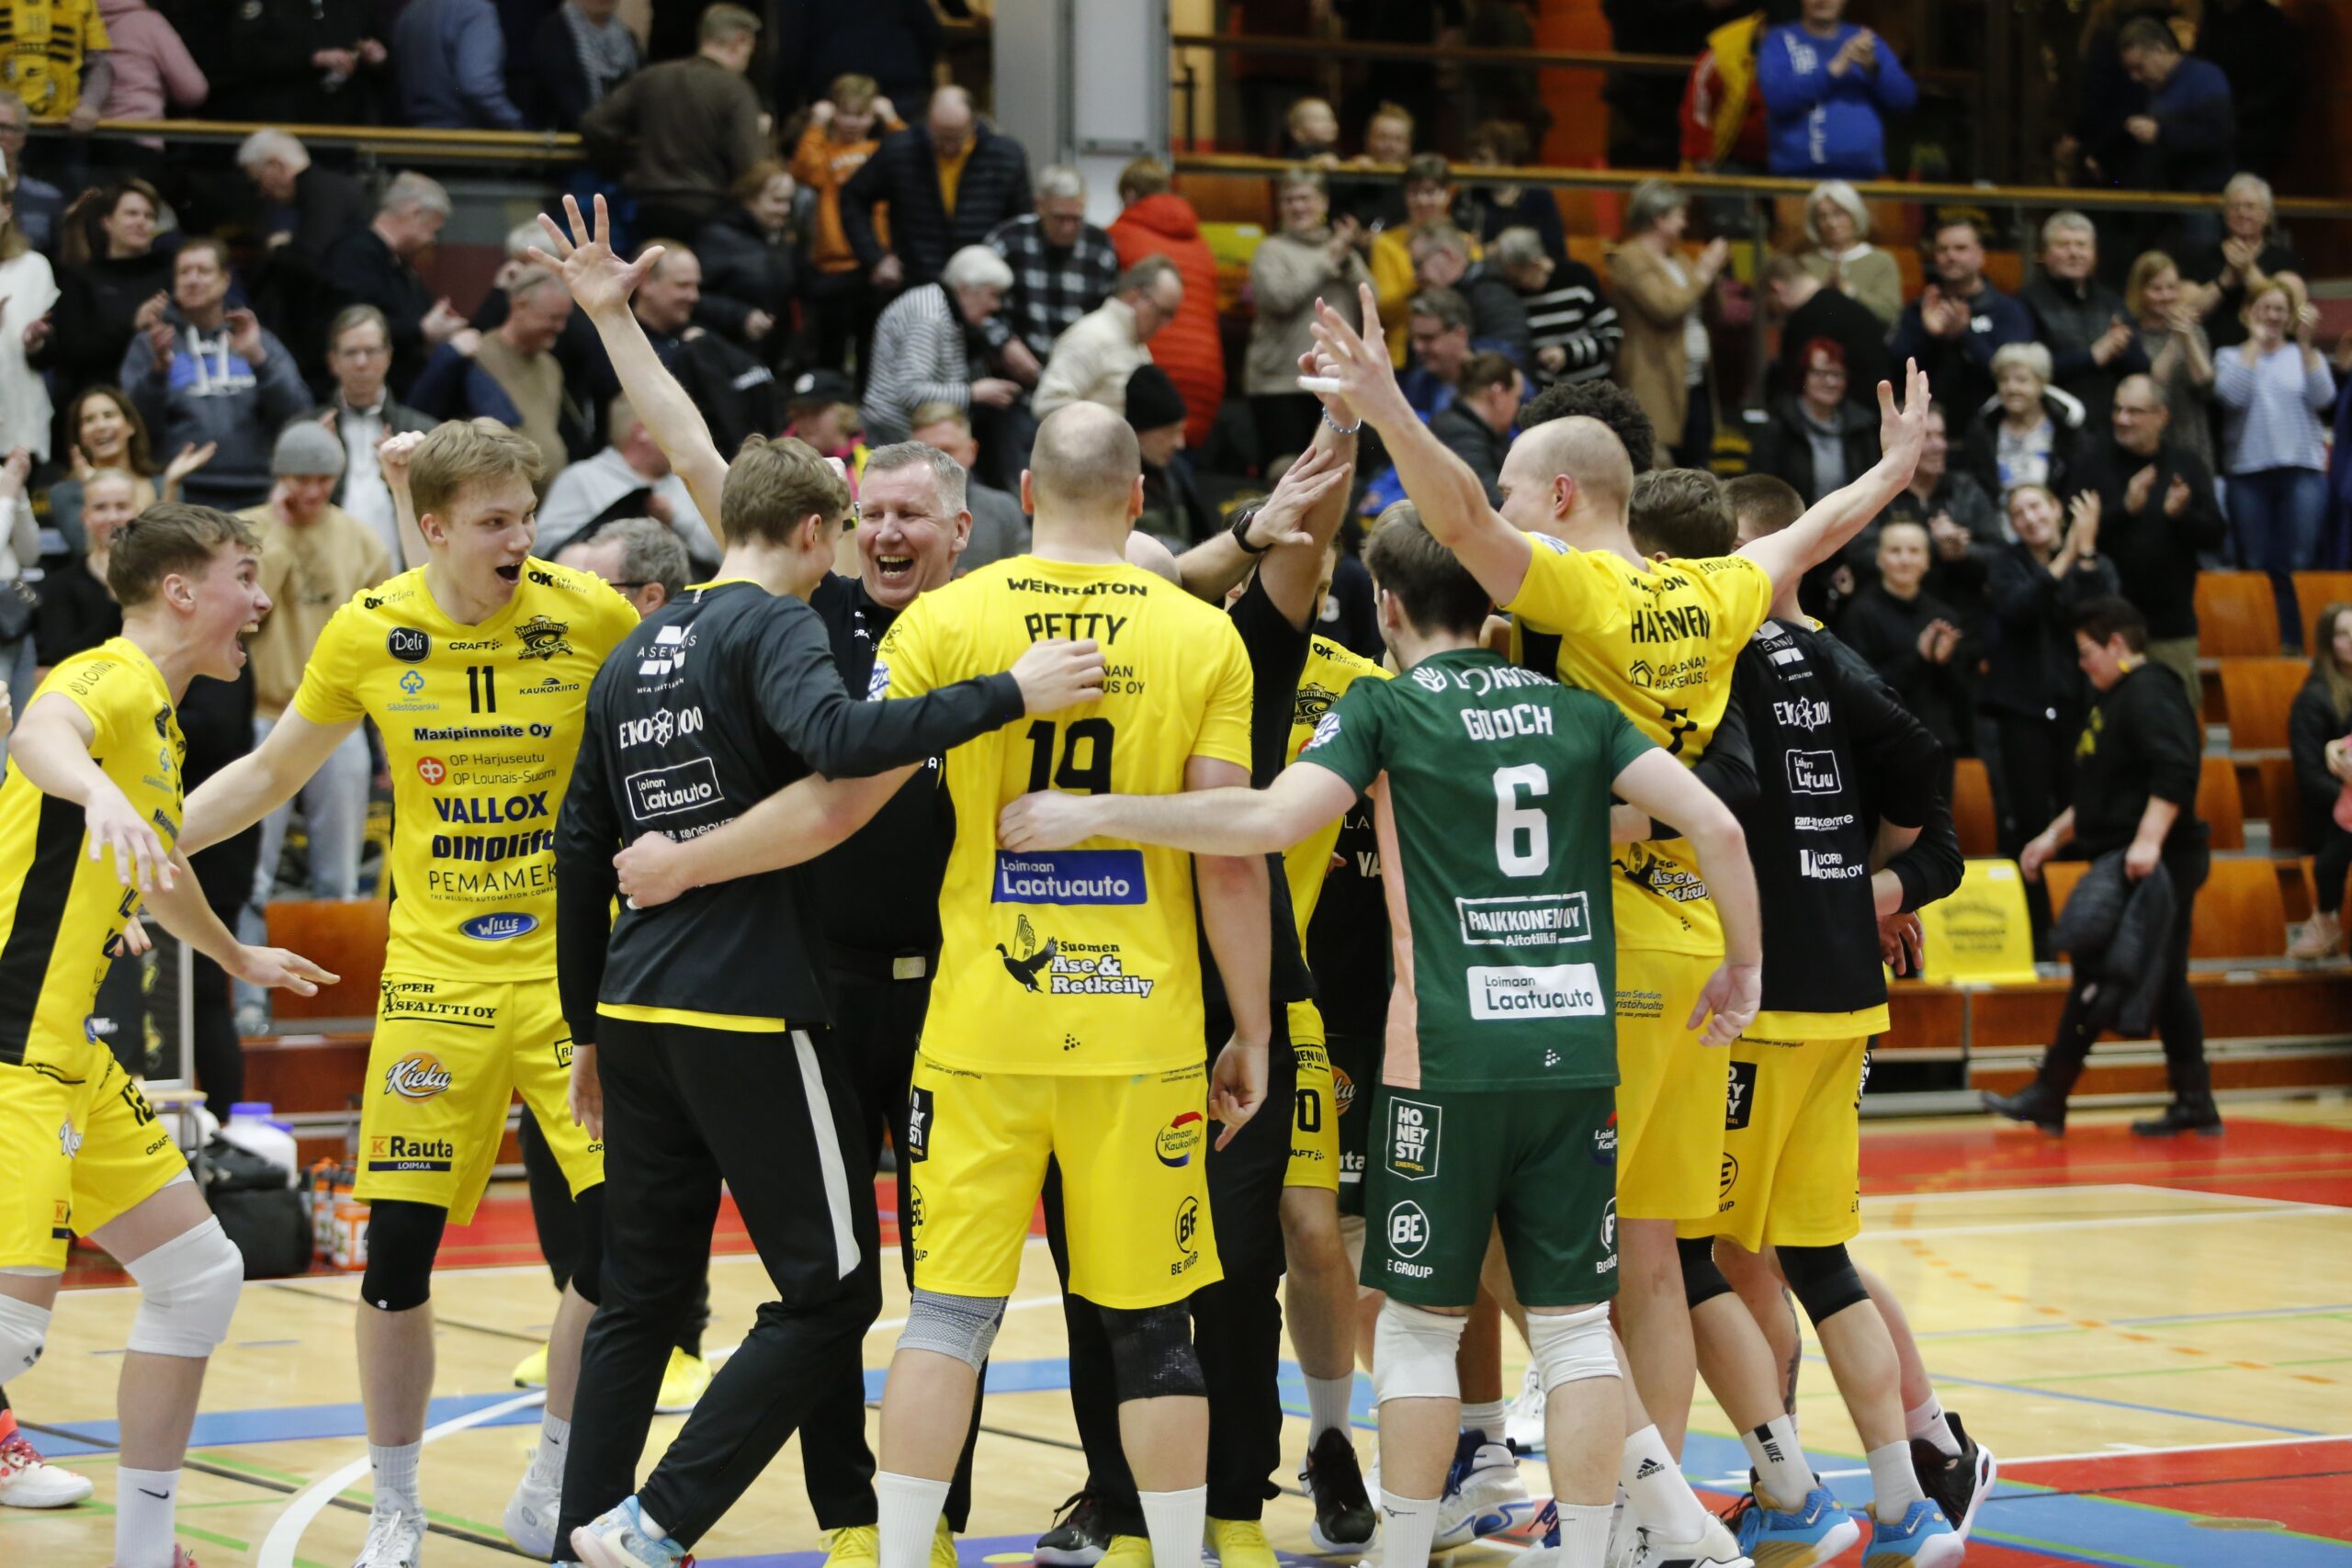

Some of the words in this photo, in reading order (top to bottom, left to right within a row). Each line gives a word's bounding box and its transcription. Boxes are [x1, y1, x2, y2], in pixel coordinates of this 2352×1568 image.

[528, 571, 553, 587] OK
[1024, 613, 1127, 645] PETTY
[391, 630, 424, 650] Deli
[449, 641, 491, 650] CRAFT
[466, 666, 496, 714] 11
[519, 683, 580, 695] KAUKOKIITO
[1126, 682, 1146, 694] OY
[413, 726, 524, 740] Maxipinnoite
[529, 724, 552, 739] Oy
[1460, 704, 1554, 740] GOOCH
[449, 754, 469, 766] OP
[473, 753, 545, 767] Harjuseutu
[1026, 717, 1114, 795] 19
[453, 773, 469, 785] OP
[473, 769, 556, 784] Lounais-Suomi
[432, 791, 549, 824] VALLOX
[1493, 763, 1550, 877] 6
[1001, 858, 1055, 873] Loimaan
[1848, 864, 1863, 877] OY
[429, 863, 557, 894] PEMAMEK
[1002, 872, 1130, 897] Laatuauto
[476, 893, 527, 902] AUTOMATION
[531, 886, 557, 897] COMPA
[1060, 941, 1120, 953] Suomen
[1050, 954, 1097, 974] Ase
[1097, 954, 1122, 976] &
[1050, 976, 1154, 998] Retkeily
[1485, 976, 1535, 987] Loimaan
[1487, 988, 1593, 1010] Laatuauto
[473, 1007, 497, 1019] OY
[384, 1057, 452, 1097] Kieku
[1397, 1106, 1423, 1126] HO
[1396, 1123, 1430, 1145] NEY
[371, 1140, 386, 1155] K
[390, 1136, 453, 1158] Rauta
[1291, 1149, 1315, 1158] AFT
[1396, 1142, 1426, 1162] STY
[398, 1161, 432, 1170] LOIMAA
[1393, 1213, 1423, 1244] BE
[1171, 1262, 1182, 1276] BE
[1394, 1261, 1433, 1279] GROUP
[1762, 1442, 1784, 1462] NIKE
[1636, 1463, 1665, 1480] adidas
